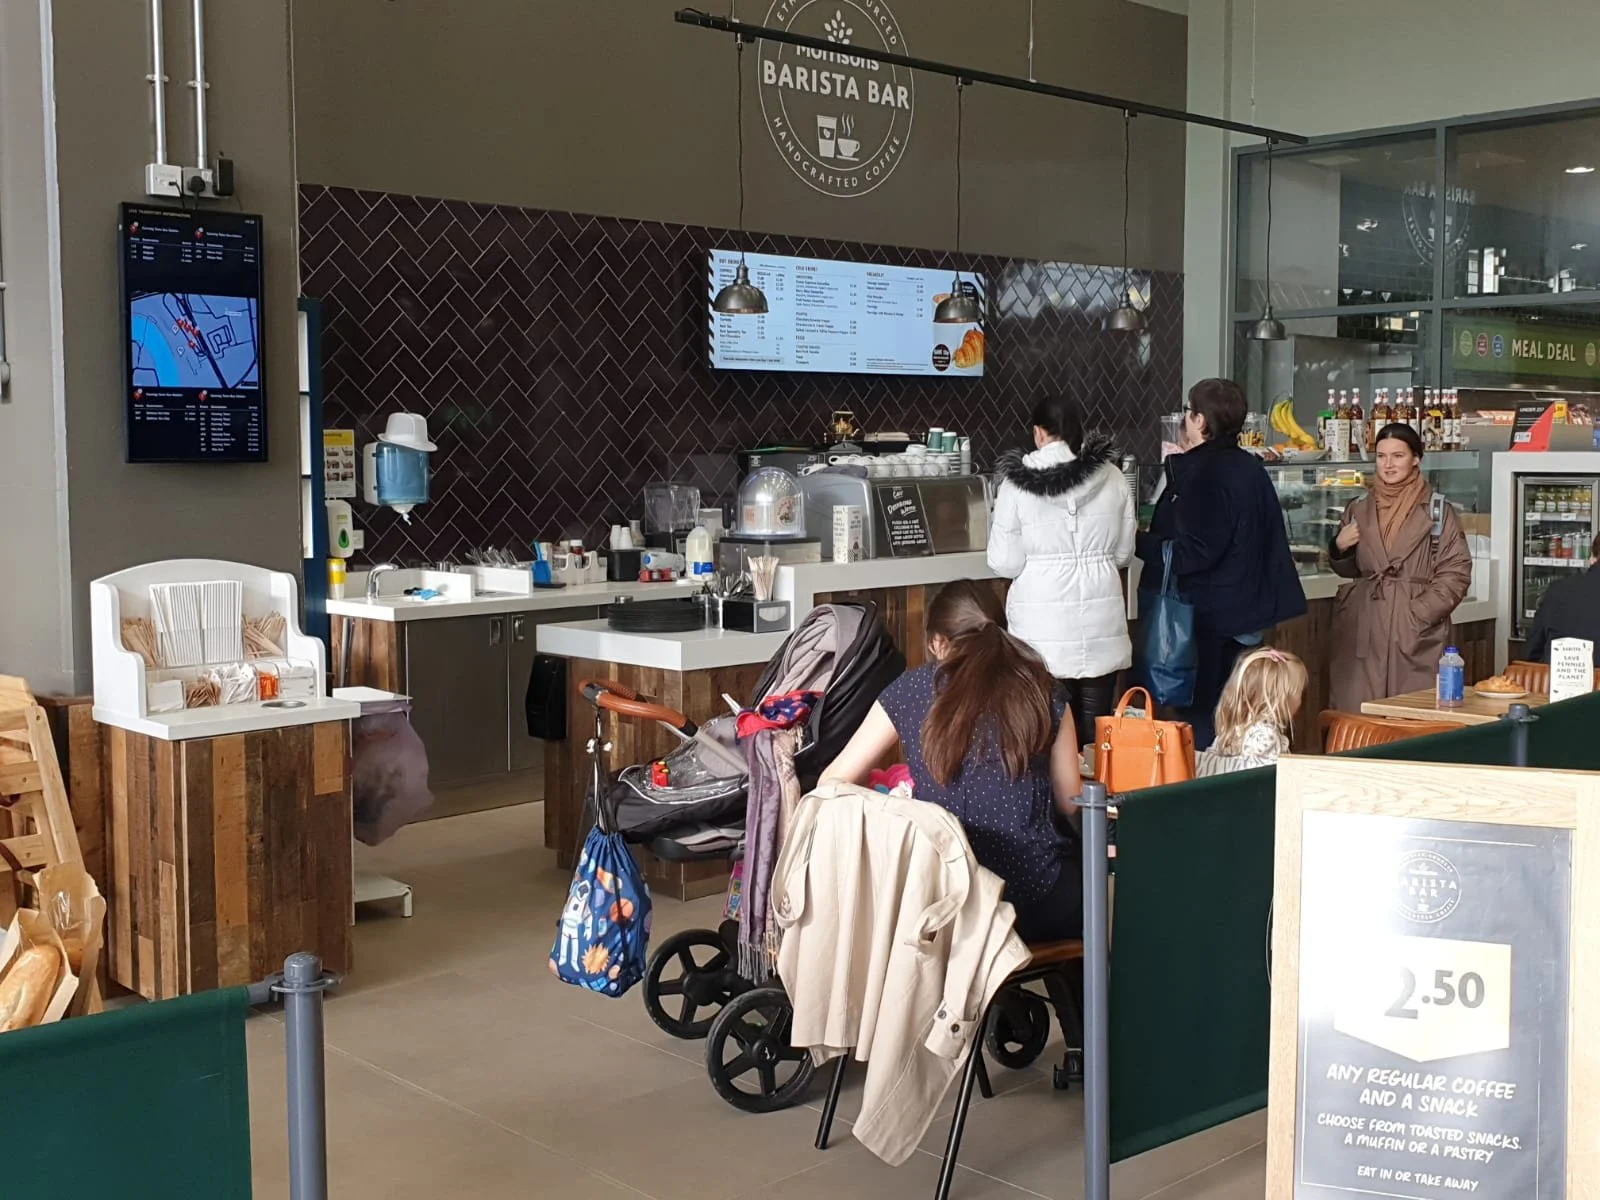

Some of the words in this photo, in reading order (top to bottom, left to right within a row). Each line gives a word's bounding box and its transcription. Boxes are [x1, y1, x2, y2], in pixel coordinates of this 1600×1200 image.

[764, 60, 859, 100] BARISTA
[868, 80, 910, 109] BAR
[774, 117, 857, 187] HANDCRAFTED
[866, 136, 900, 180] COFFEE
[1512, 338, 1543, 359] MEAL
[1547, 342, 1576, 361] DEAL
[1326, 1063, 1364, 1083] ANY
[1367, 1068, 1447, 1091] REGULAR
[1451, 1077, 1516, 1100] COFFEE
[1360, 1088, 1396, 1107] AND
[1401, 1093, 1413, 1110] A
[1418, 1095, 1479, 1118] SNACK
[1317, 1113, 1366, 1130] CHOOSE
[1369, 1118, 1405, 1135] FROM
[1409, 1124, 1464, 1141] TOASTED
[1344, 1132, 1353, 1145] A
[1356, 1133, 1405, 1151] MUFFIN
[1409, 1141, 1427, 1154] OR
[1430, 1143, 1439, 1156] A
[1443, 1146, 1494, 1164] PASTRY
[1357, 1165, 1377, 1177] EAT
[1379, 1168, 1393, 1180] IN
[1394, 1170, 1411, 1182] OR
[1414, 1172, 1442, 1187] TAKE
[1444, 1176, 1479, 1192] AWAY
